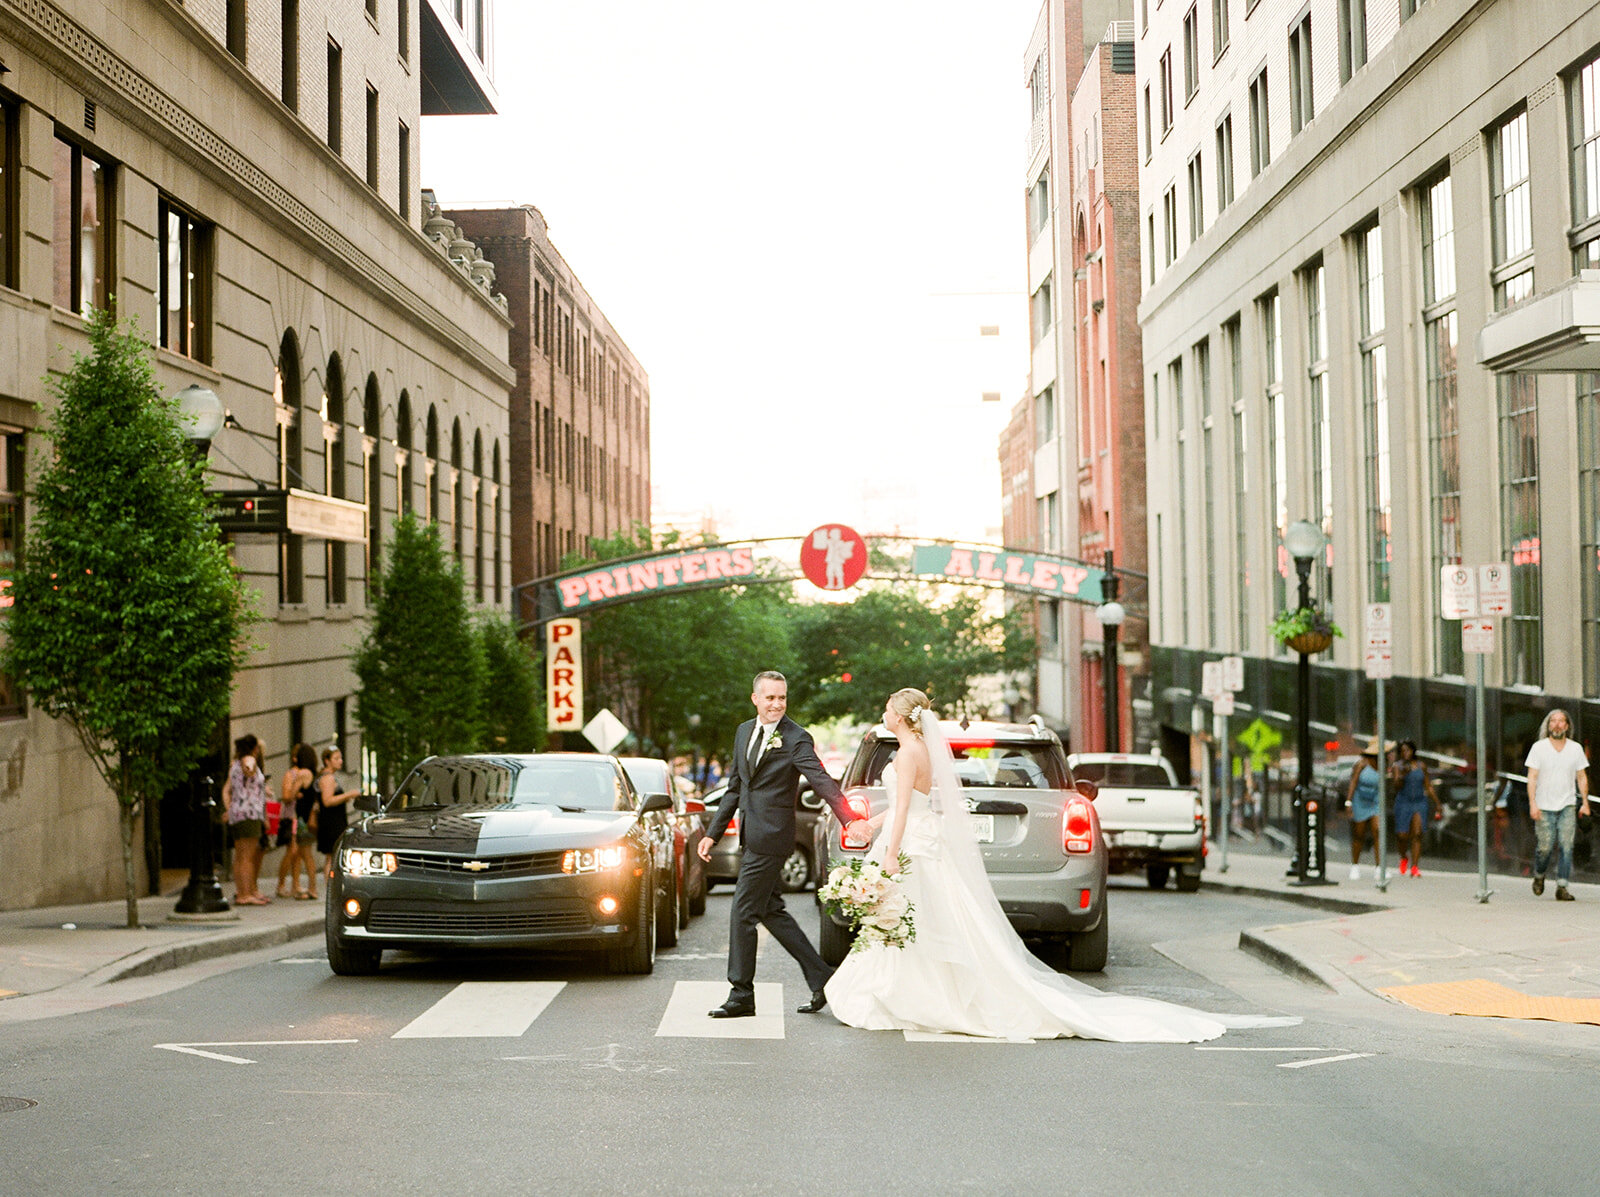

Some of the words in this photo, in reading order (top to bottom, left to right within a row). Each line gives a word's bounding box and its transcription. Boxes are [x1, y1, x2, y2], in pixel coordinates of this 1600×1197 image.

[559, 548, 754, 608] PRINTERS
[944, 549, 1088, 594] ALLEY
[552, 624, 575, 709] PARK
